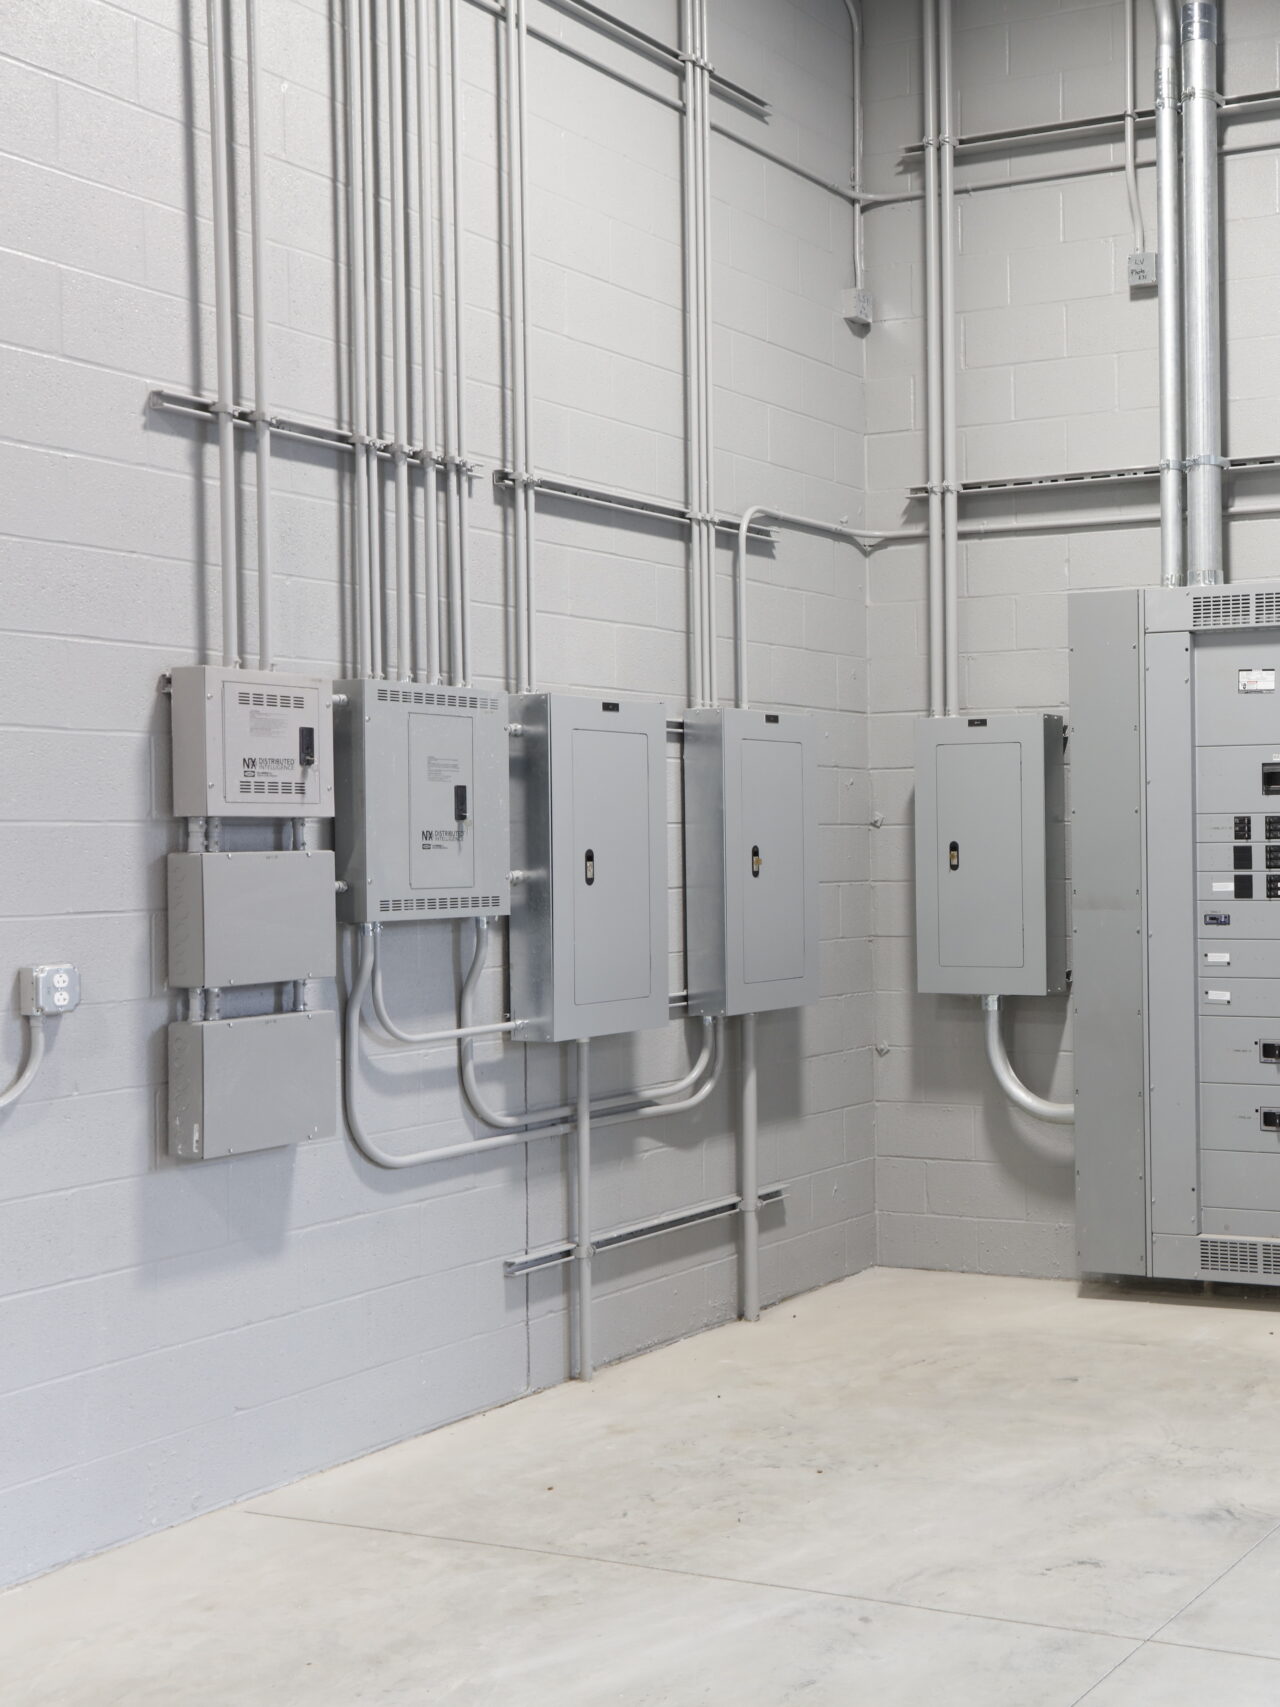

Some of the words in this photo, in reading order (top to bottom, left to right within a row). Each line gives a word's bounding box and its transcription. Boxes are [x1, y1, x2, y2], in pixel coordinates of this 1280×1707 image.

[242, 757, 257, 770] NX
[258, 757, 295, 765] DISTRIBUTED
[421, 830, 433, 841] NX
